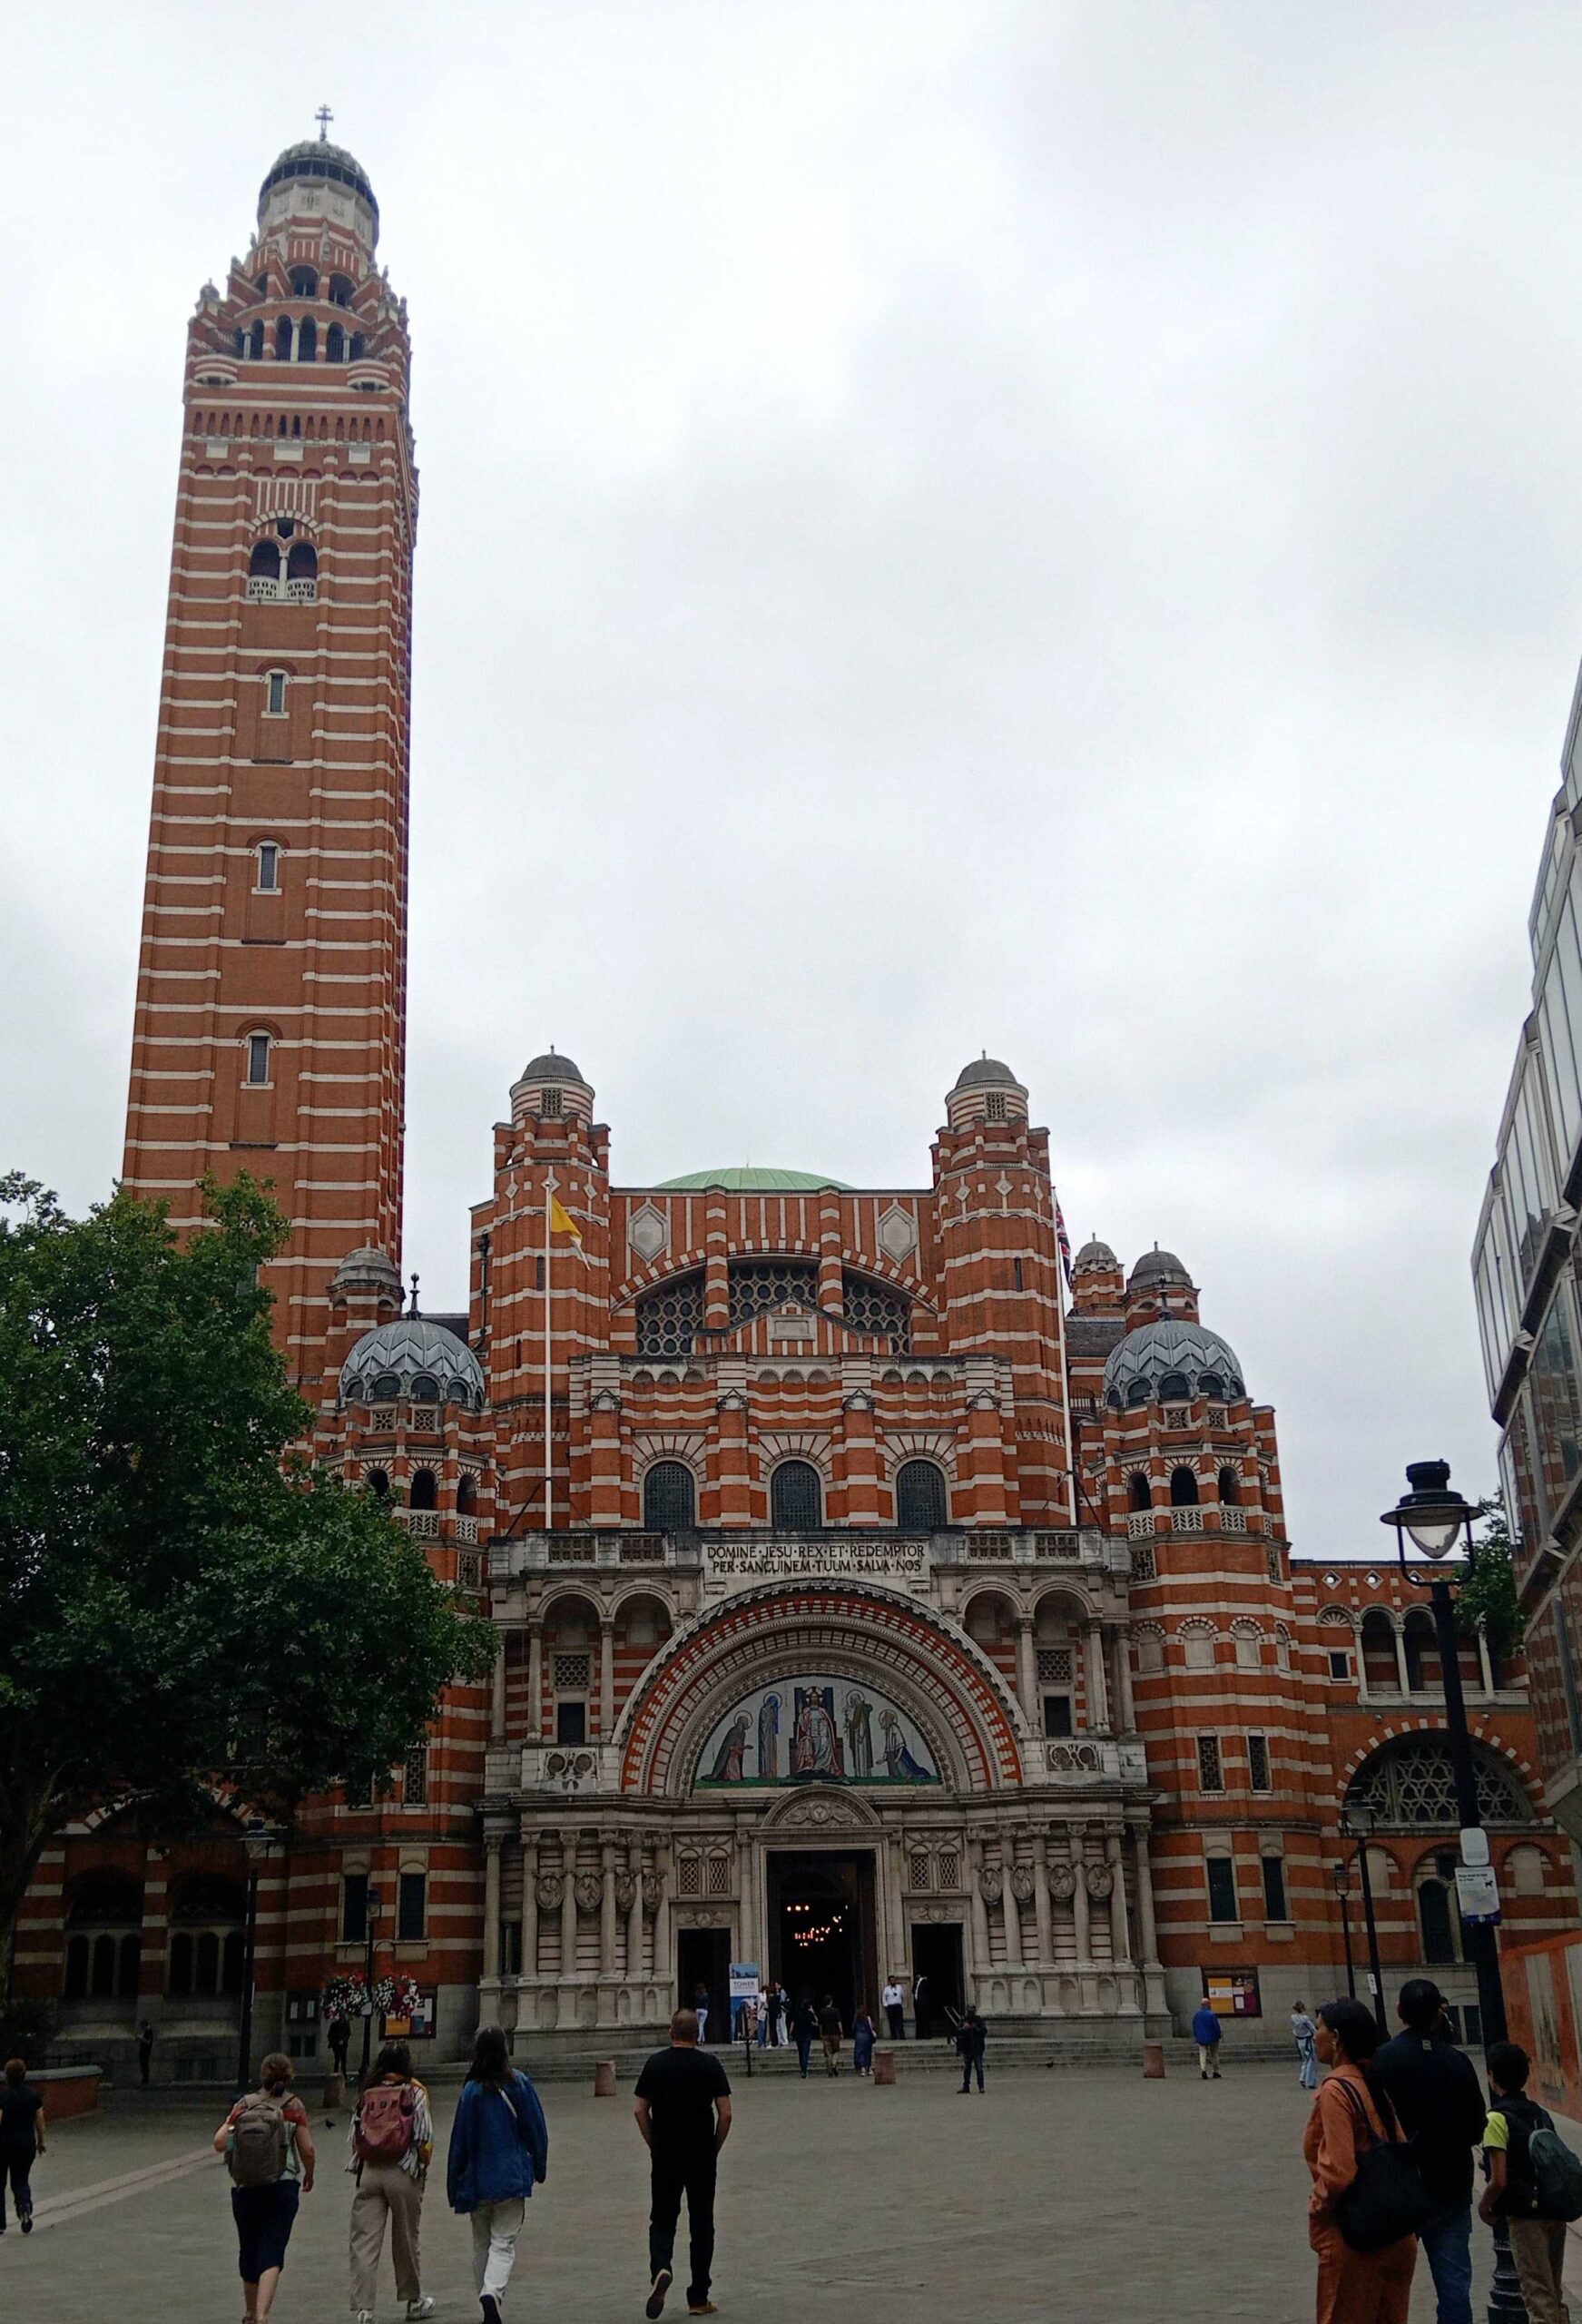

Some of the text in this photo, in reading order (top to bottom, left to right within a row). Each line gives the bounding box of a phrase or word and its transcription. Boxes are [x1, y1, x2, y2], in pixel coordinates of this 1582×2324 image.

[707, 1545, 925, 1559] DOMINE JESU REX ET REDEMPTOR
[712, 1560, 921, 1572] PER SANGUINEM TUUM SALVA NOS
